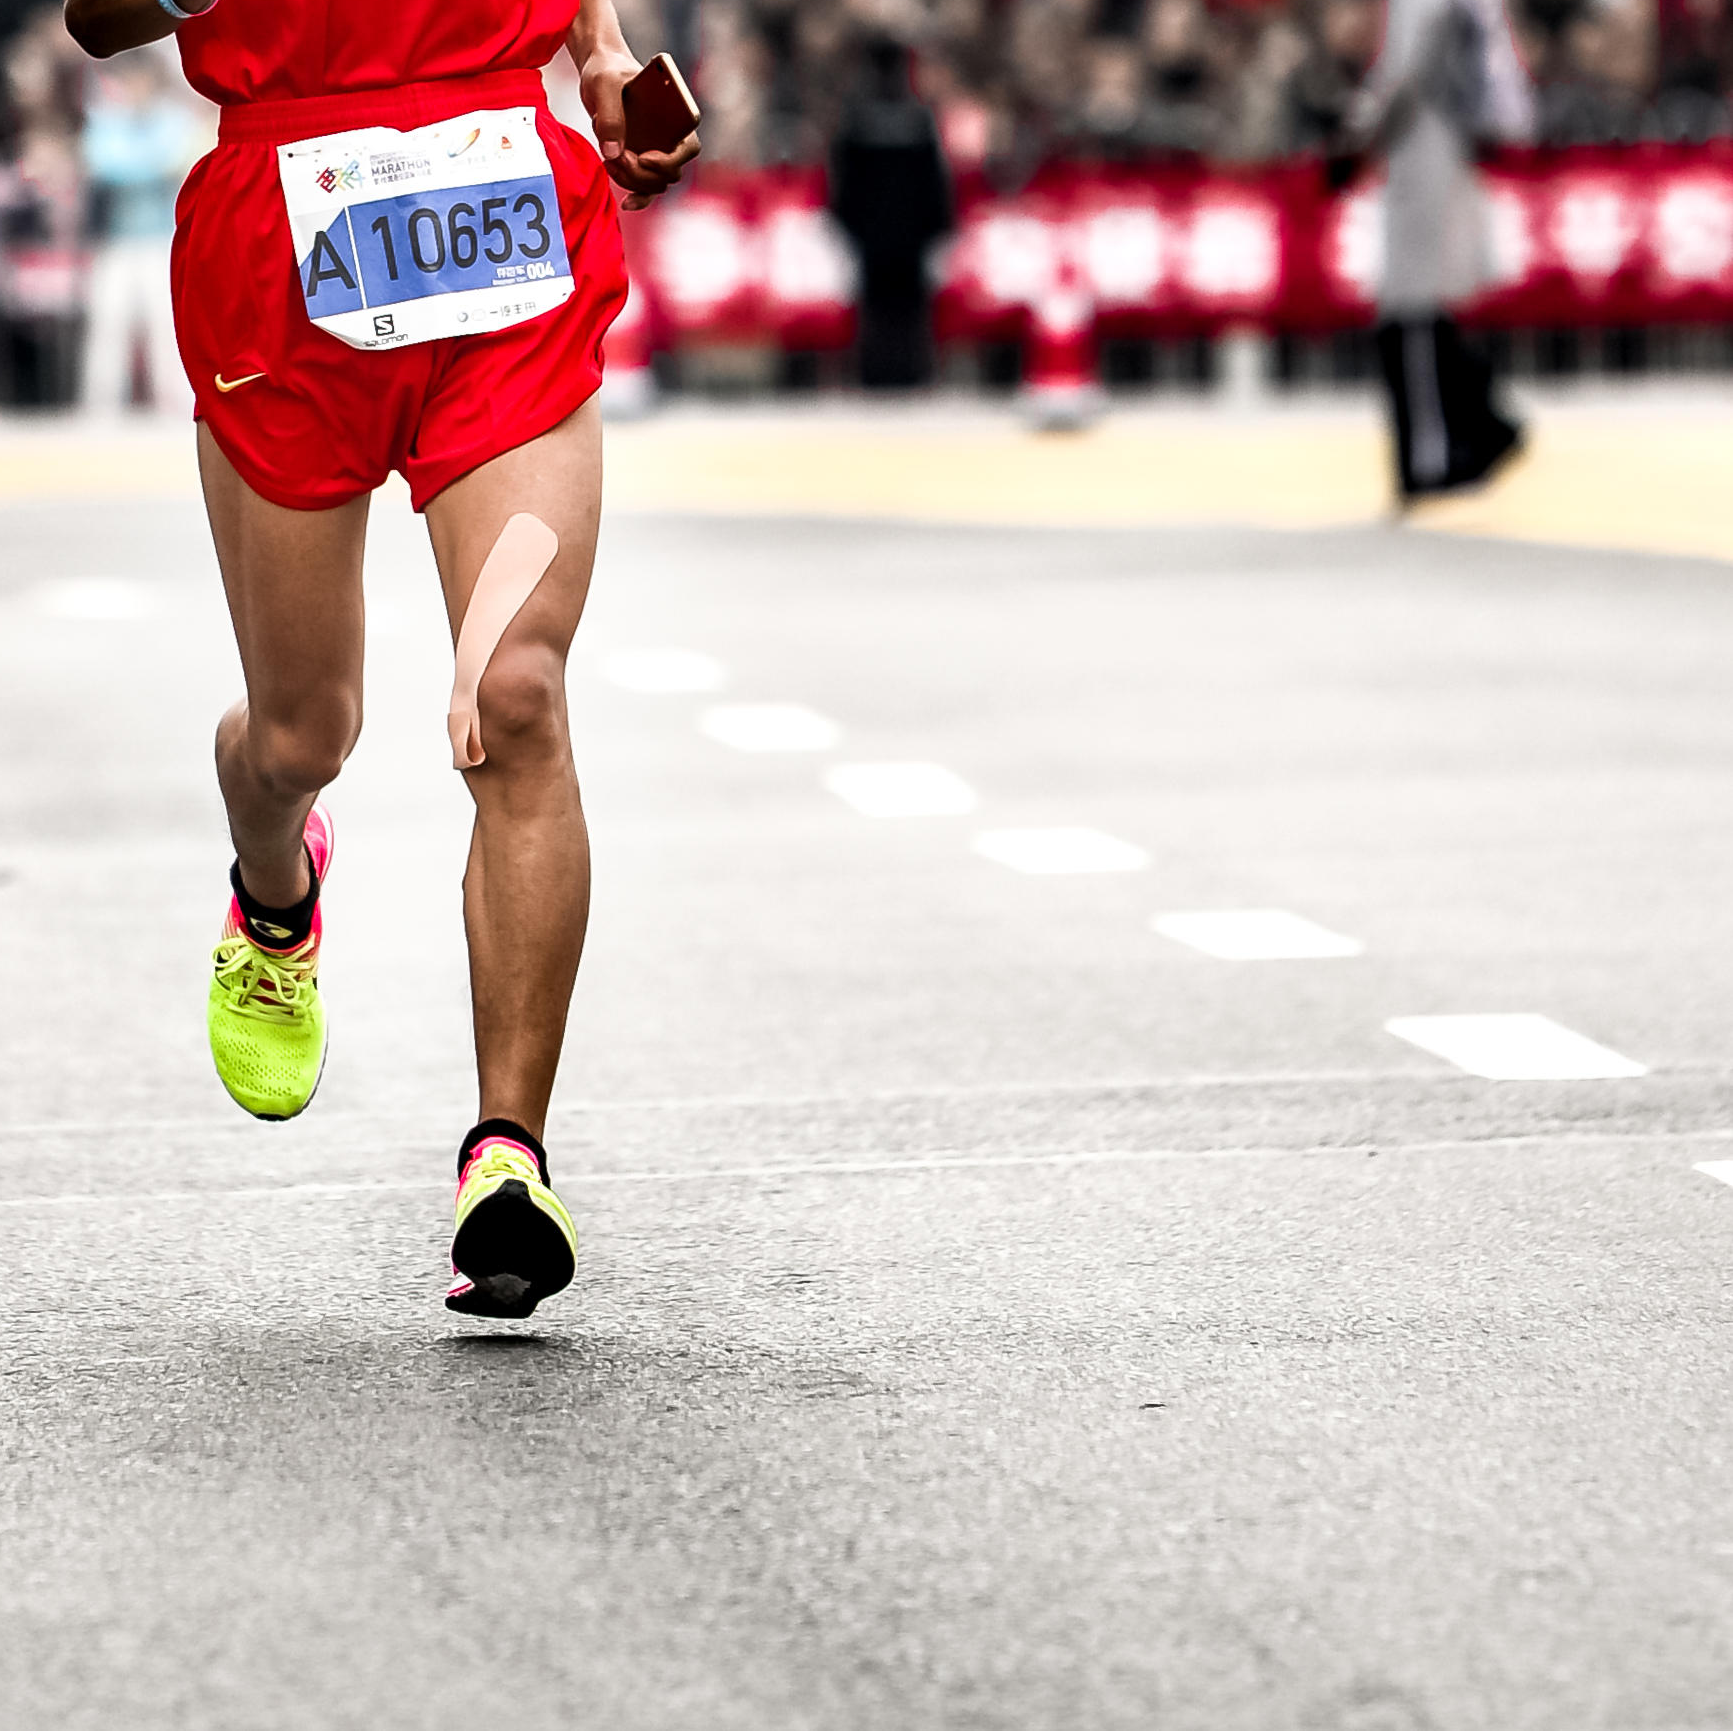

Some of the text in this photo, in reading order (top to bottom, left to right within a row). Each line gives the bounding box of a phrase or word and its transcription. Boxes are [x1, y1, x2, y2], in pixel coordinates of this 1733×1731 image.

[370, 159, 431, 177] MARATHON
[306, 193, 550, 297] A 10653
[527, 260, 556, 280] 004
